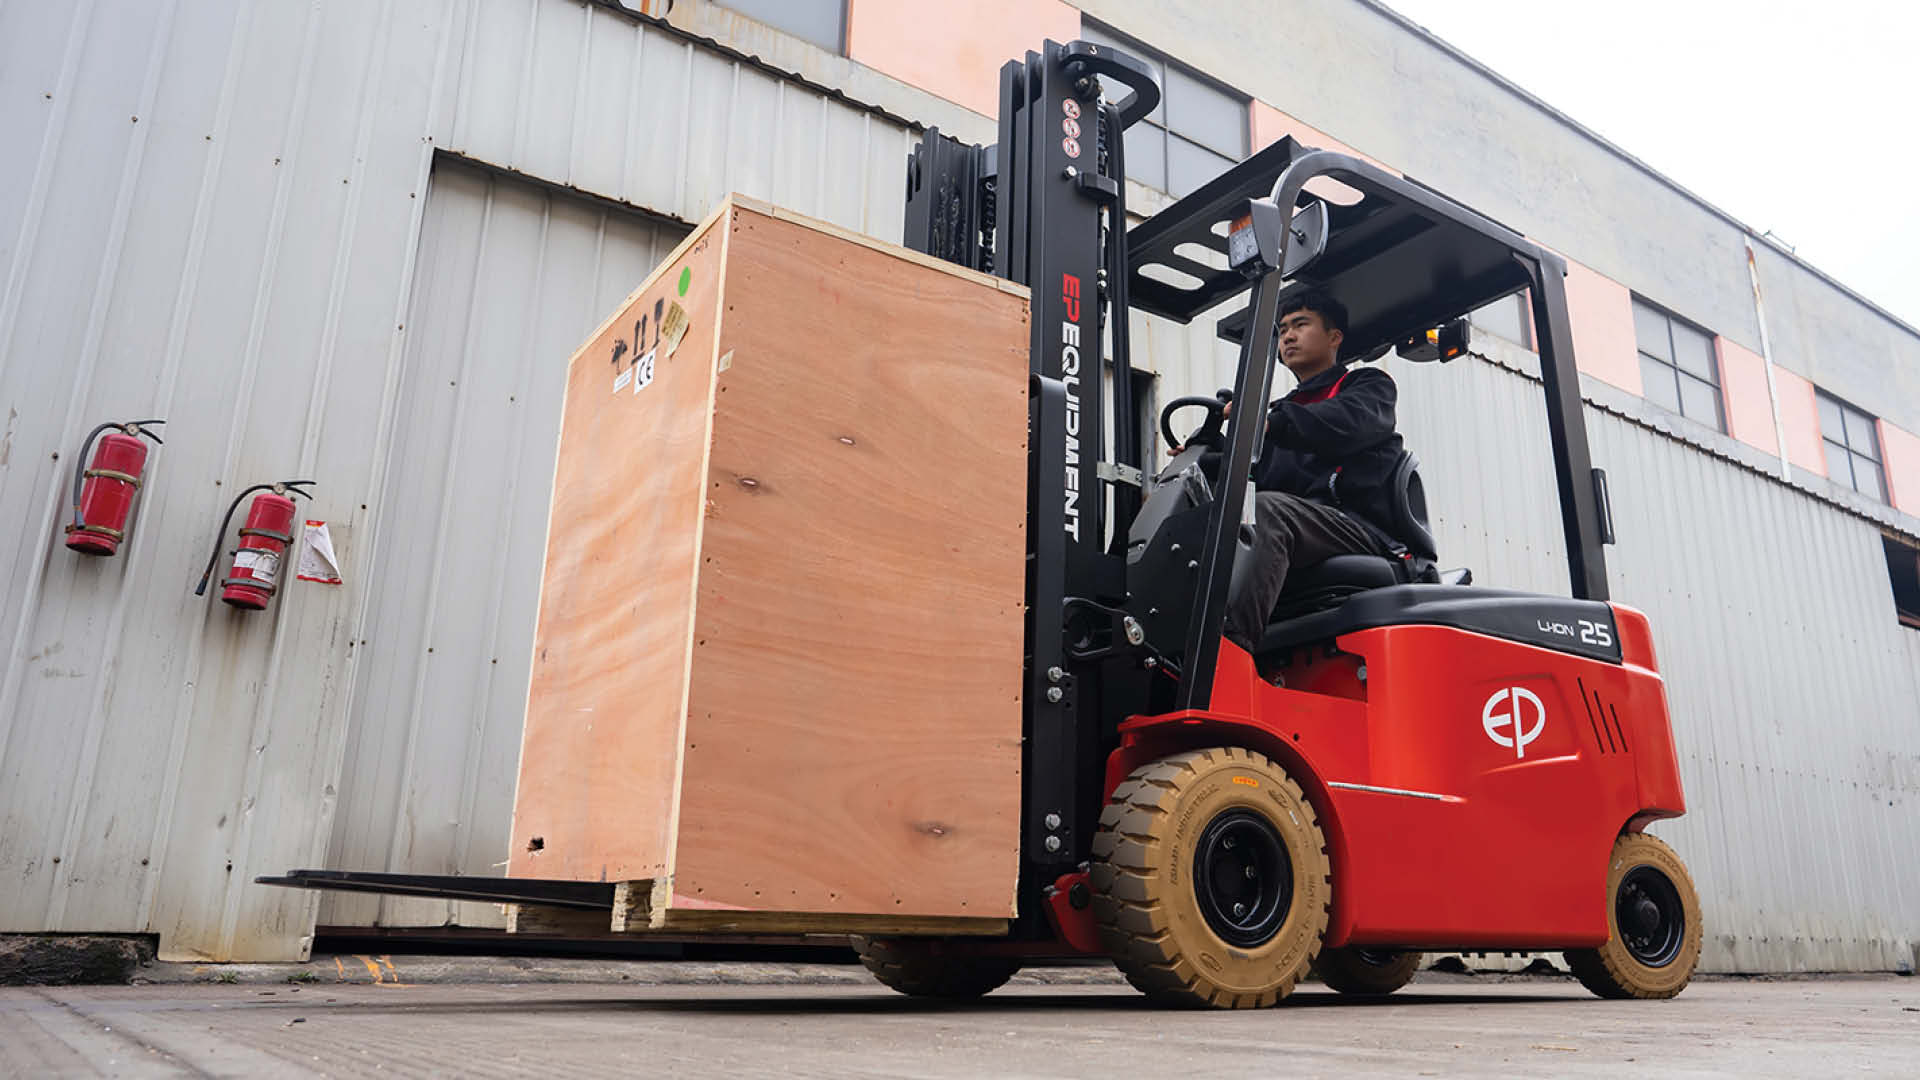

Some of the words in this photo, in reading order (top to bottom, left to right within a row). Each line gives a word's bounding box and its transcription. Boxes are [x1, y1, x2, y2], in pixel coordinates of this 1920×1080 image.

[1063, 273, 1080, 322] EP
[1578, 620, 1612, 647] 25
[1482, 686, 1546, 758] EP
